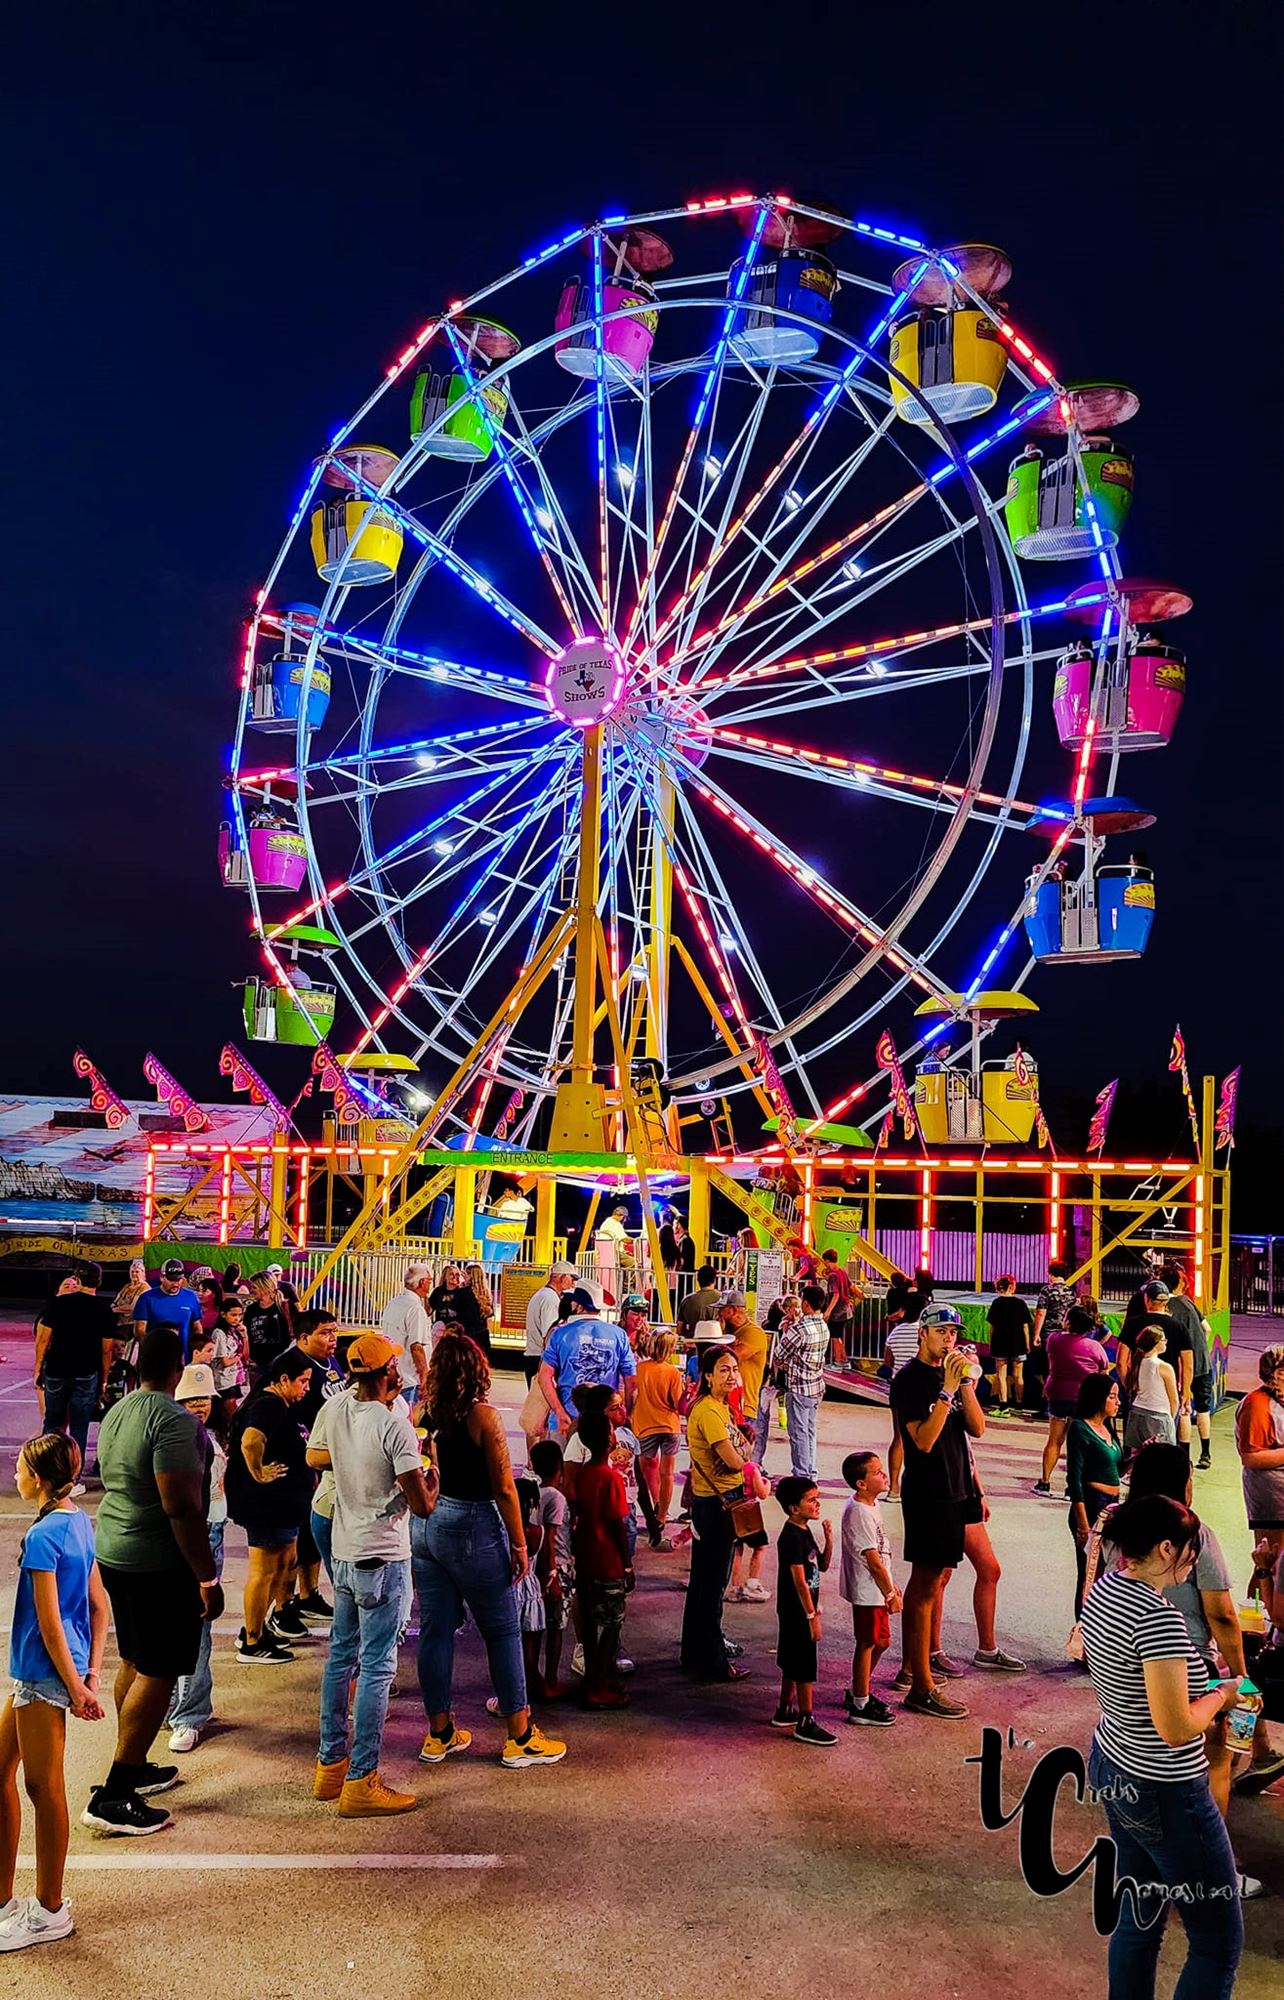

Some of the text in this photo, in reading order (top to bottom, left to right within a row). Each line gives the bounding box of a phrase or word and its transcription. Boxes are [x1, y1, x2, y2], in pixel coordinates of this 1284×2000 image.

[558, 664, 577, 677] PRIDE
[589, 659, 612, 669] TEXAS
[564, 685, 605, 702] SHOWS
[493, 1151, 553, 1164] ENTRANCE
[76, 1244, 128, 1257] TEXAS
